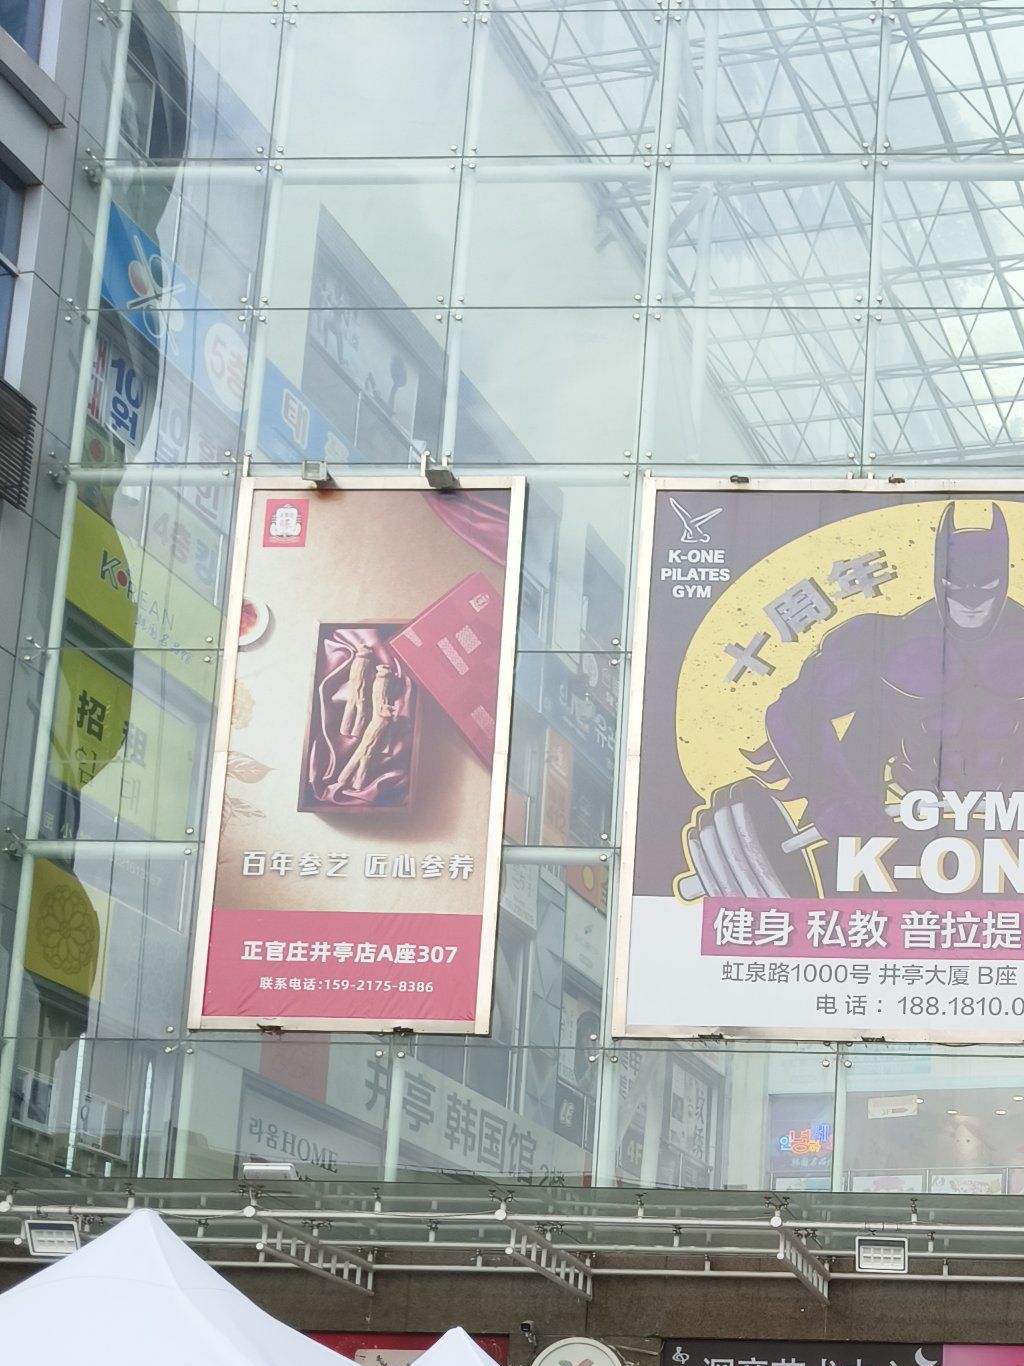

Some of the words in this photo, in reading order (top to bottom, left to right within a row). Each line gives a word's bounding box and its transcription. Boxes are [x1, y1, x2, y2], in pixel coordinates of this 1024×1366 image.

[668, 550, 724, 564] K-ONE
[661, 568, 731, 582] PILATES
[672, 585, 712, 599] GYM
[722, 550, 897, 684] 十周年
[241, 851, 354, 880] 百年参艺
[713, 907, 796, 947] 健身
[806, 909, 888, 949] 私教
[899, 911, 1022, 950] 普拉提
[241, 940, 458, 965] 正官庄井亭店A座307
[721, 962, 872, 987] 虹泉路1000号
[879, 963, 970, 987] 井亭大厦
[976, 964, 1017, 987] B座
